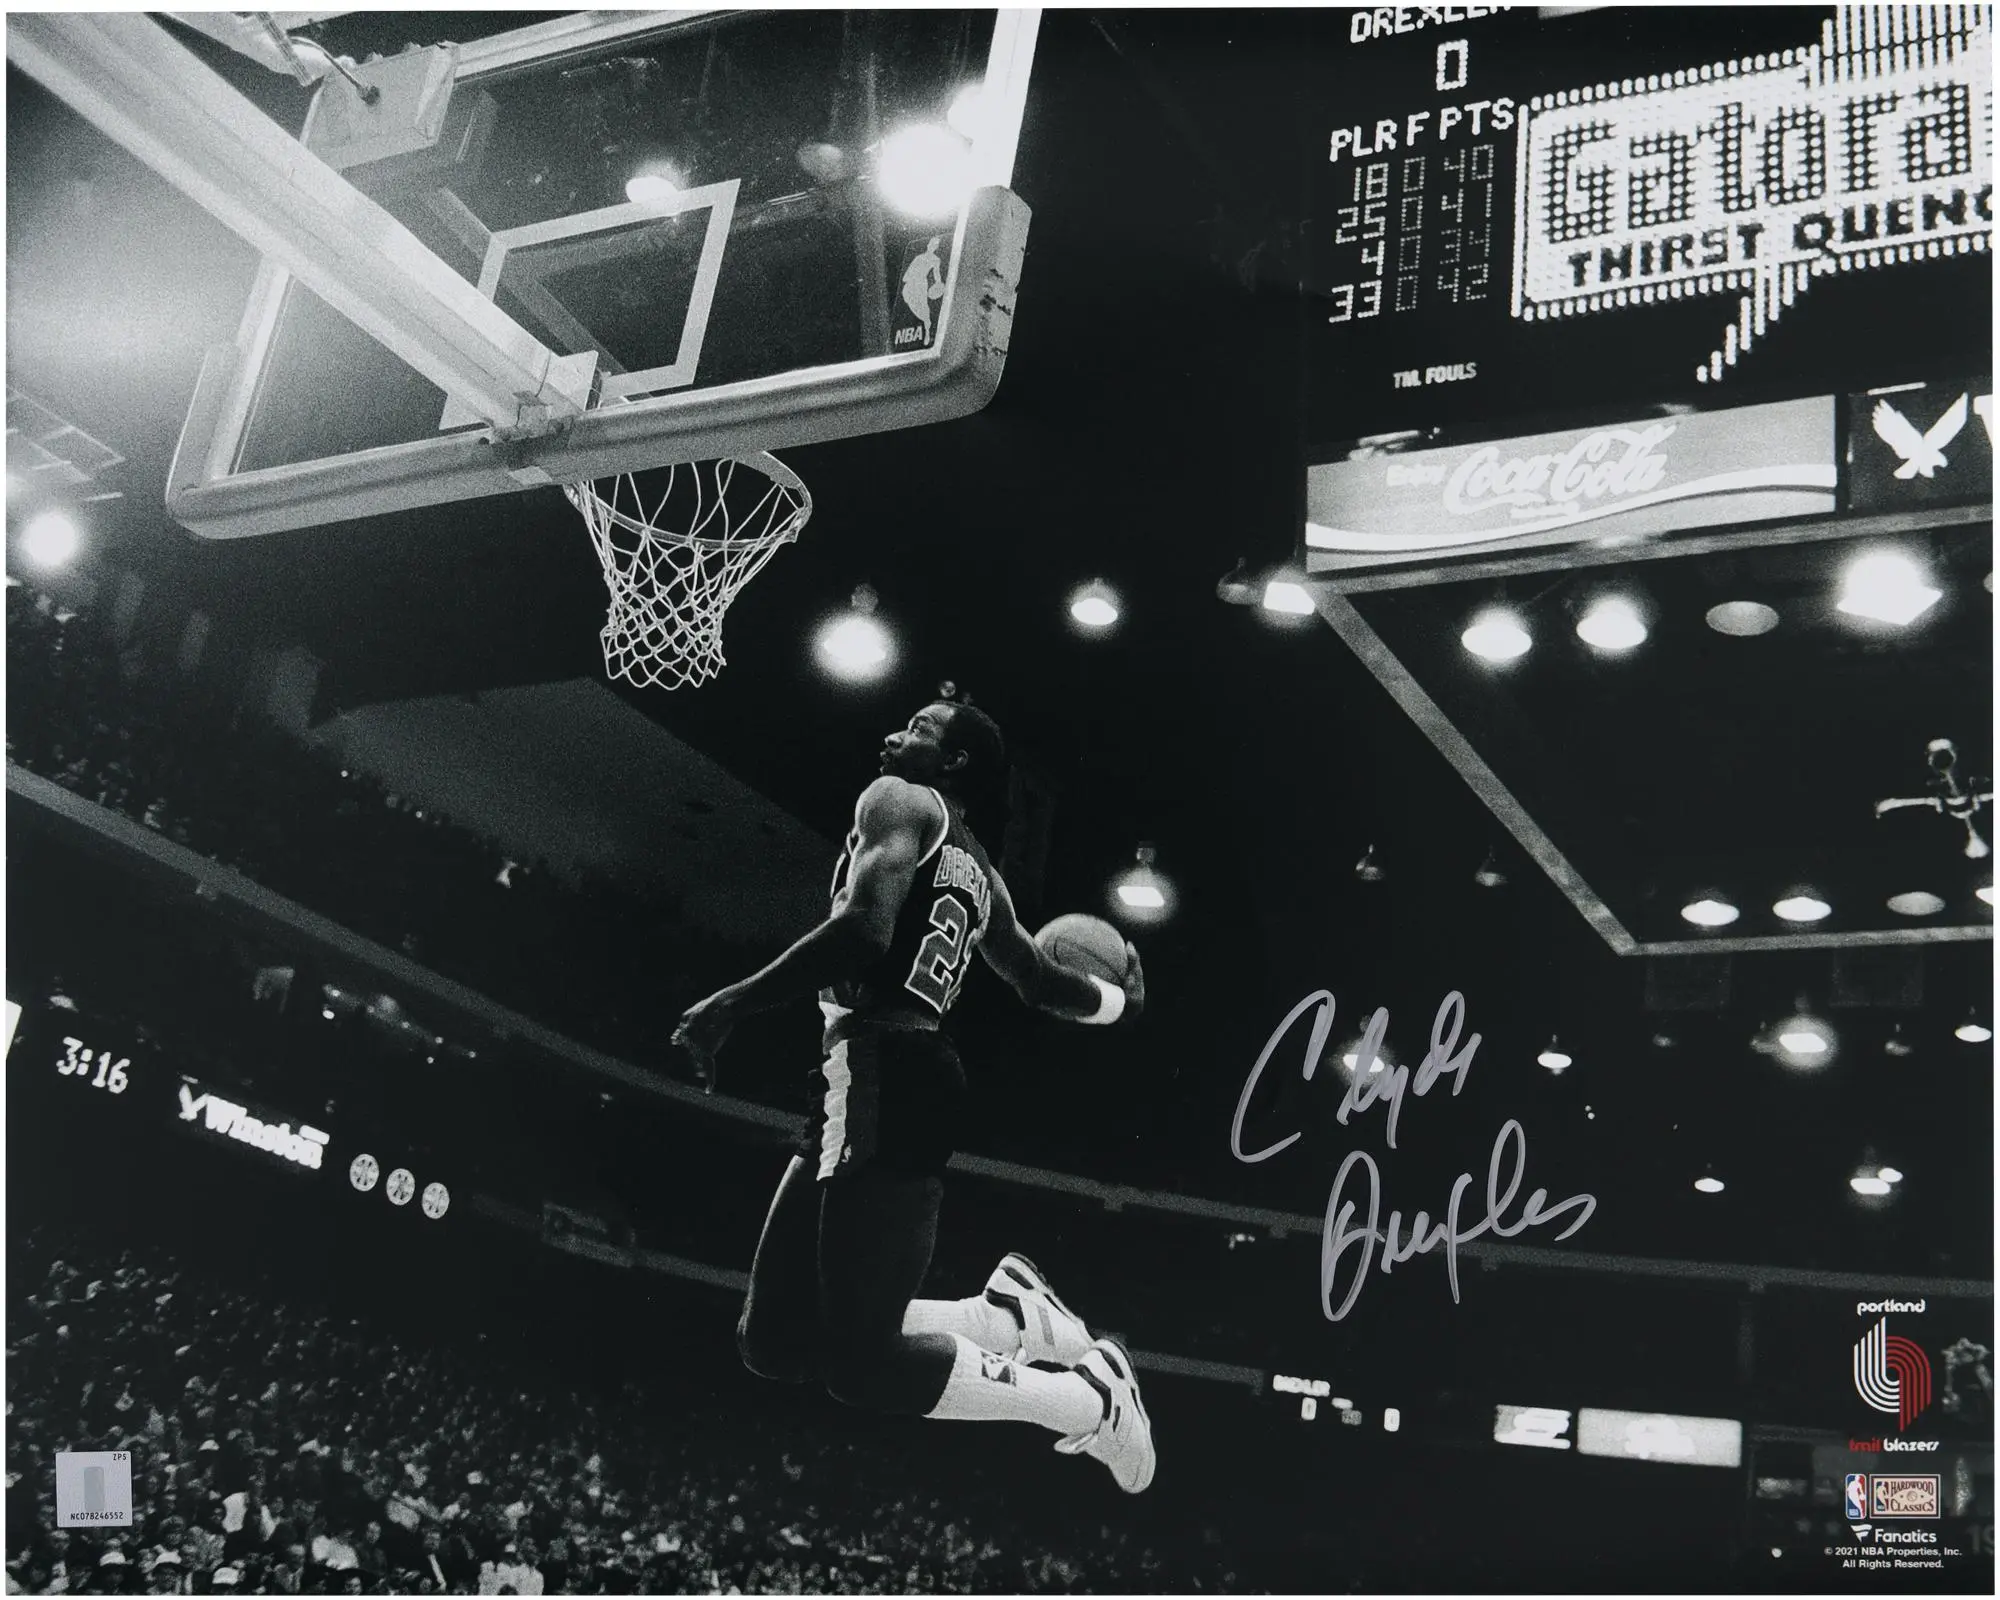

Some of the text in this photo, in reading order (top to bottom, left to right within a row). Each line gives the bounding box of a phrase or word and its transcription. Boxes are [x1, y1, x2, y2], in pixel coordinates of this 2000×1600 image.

[1350, 7, 1512, 43] DREXL
[1436, 39, 1468, 91] 0
[1330, 97, 1515, 162] PLR F PTS
[1353, 144, 1494, 201] 18 0 40
[1542, 80, 1992, 245] Gatora
[1335, 201, 1388, 244] 25
[1402, 195, 1424, 231] 0
[1361, 223, 1490, 276] 4 0 34
[1568, 222, 1765, 288] THIRST
[1329, 263, 1487, 323] 33 0 42
[894, 325, 924, 345] NBA
[1425, 362, 1477, 384] FOULS
[904, 893, 974, 1014] 2
[57, 1037, 130, 1094] 3:16
